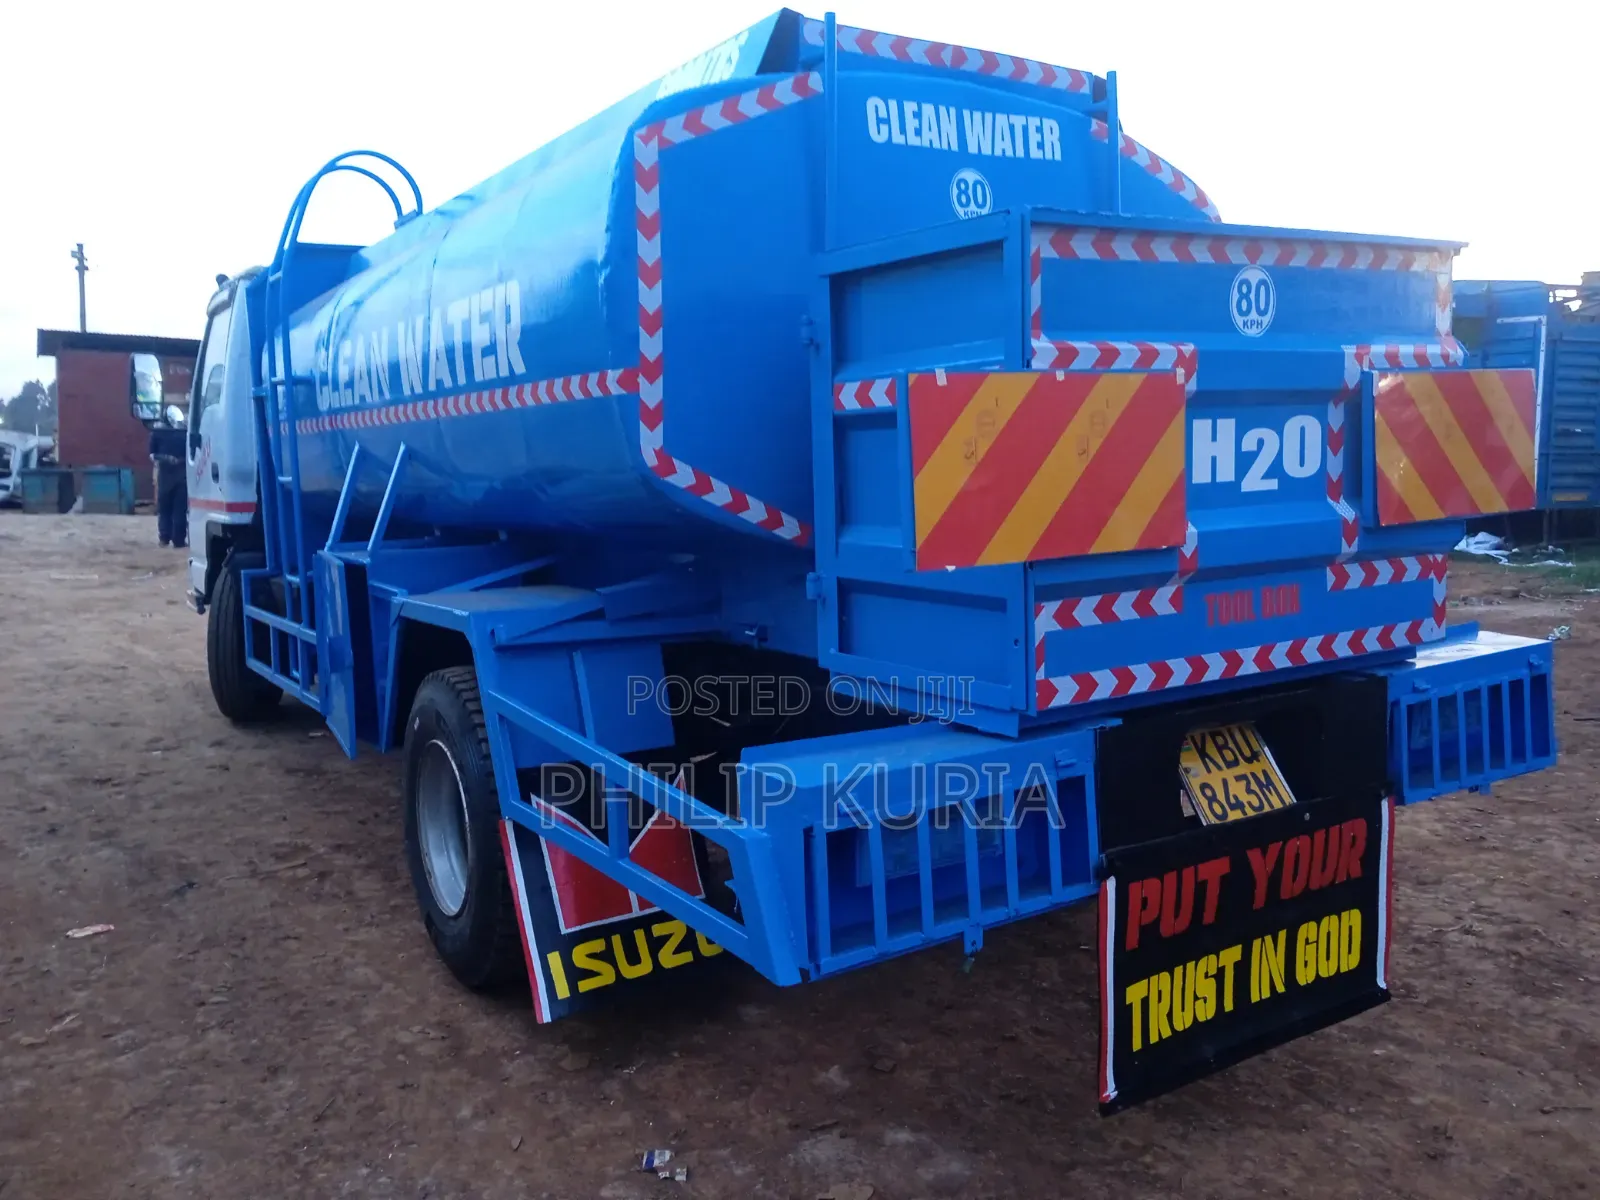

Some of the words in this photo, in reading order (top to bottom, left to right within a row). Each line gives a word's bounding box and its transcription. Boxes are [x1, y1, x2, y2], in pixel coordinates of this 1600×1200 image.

[867, 96, 959, 153] CLEAN
[963, 110, 1062, 162] WATER
[956, 178, 987, 209] 80
[1236, 278, 1270, 316] 80
[1242, 319, 1263, 329] KPH
[314, 325, 390, 412] CLEAN
[398, 279, 526, 396] WATER
[1192, 415, 1322, 492] H2O
[1199, 769, 1288, 821] 843M
[1125, 856, 1230, 951] PUT
[1246, 818, 1367, 910] YOUR
[1125, 944, 1242, 1052] TRUST
[1250, 929, 1286, 1004] IN
[1295, 908, 1362, 987] GOD
